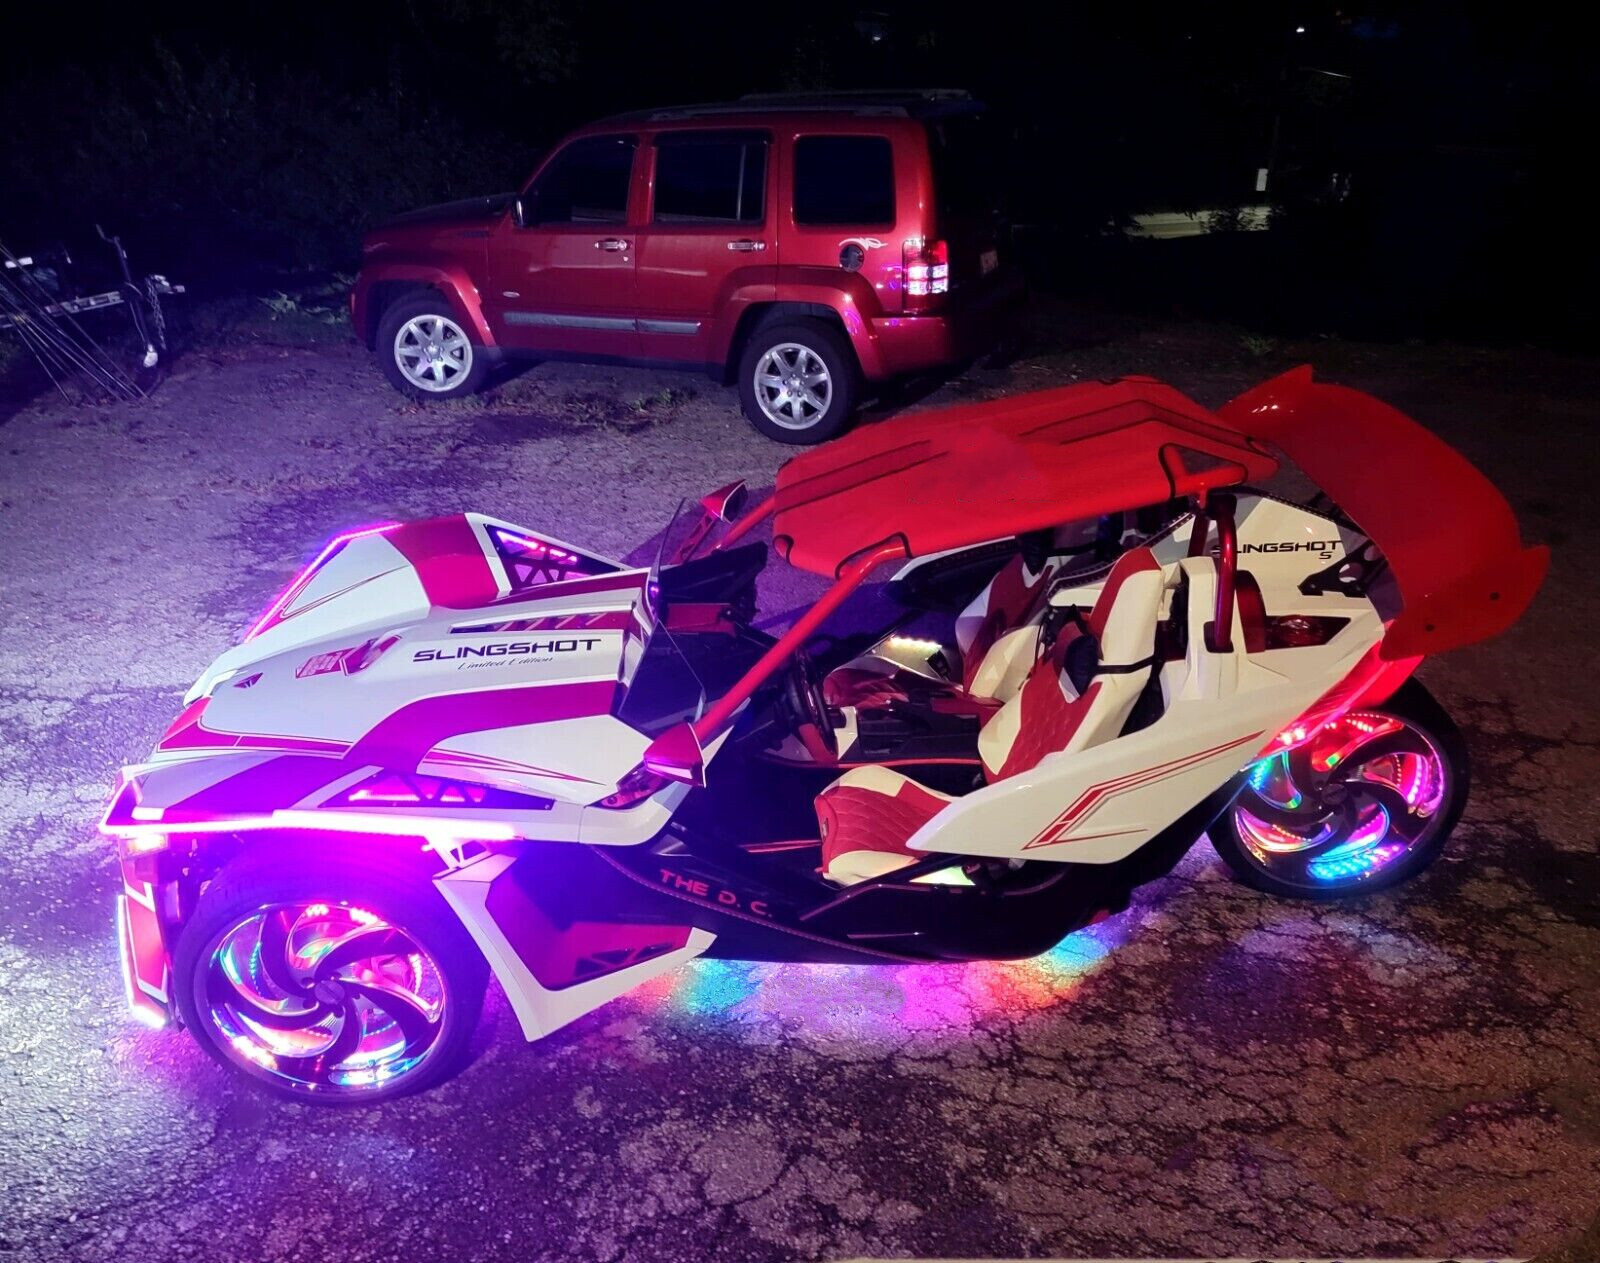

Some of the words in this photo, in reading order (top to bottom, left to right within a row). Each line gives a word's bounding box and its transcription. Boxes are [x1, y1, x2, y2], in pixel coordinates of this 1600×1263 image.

[1318, 551, 1332, 560] S
[413, 639, 601, 662] SLINGSHOT
[458, 660, 506, 670] Limited
[509, 656, 554, 667] Edition
[660, 869, 709, 896] THE
